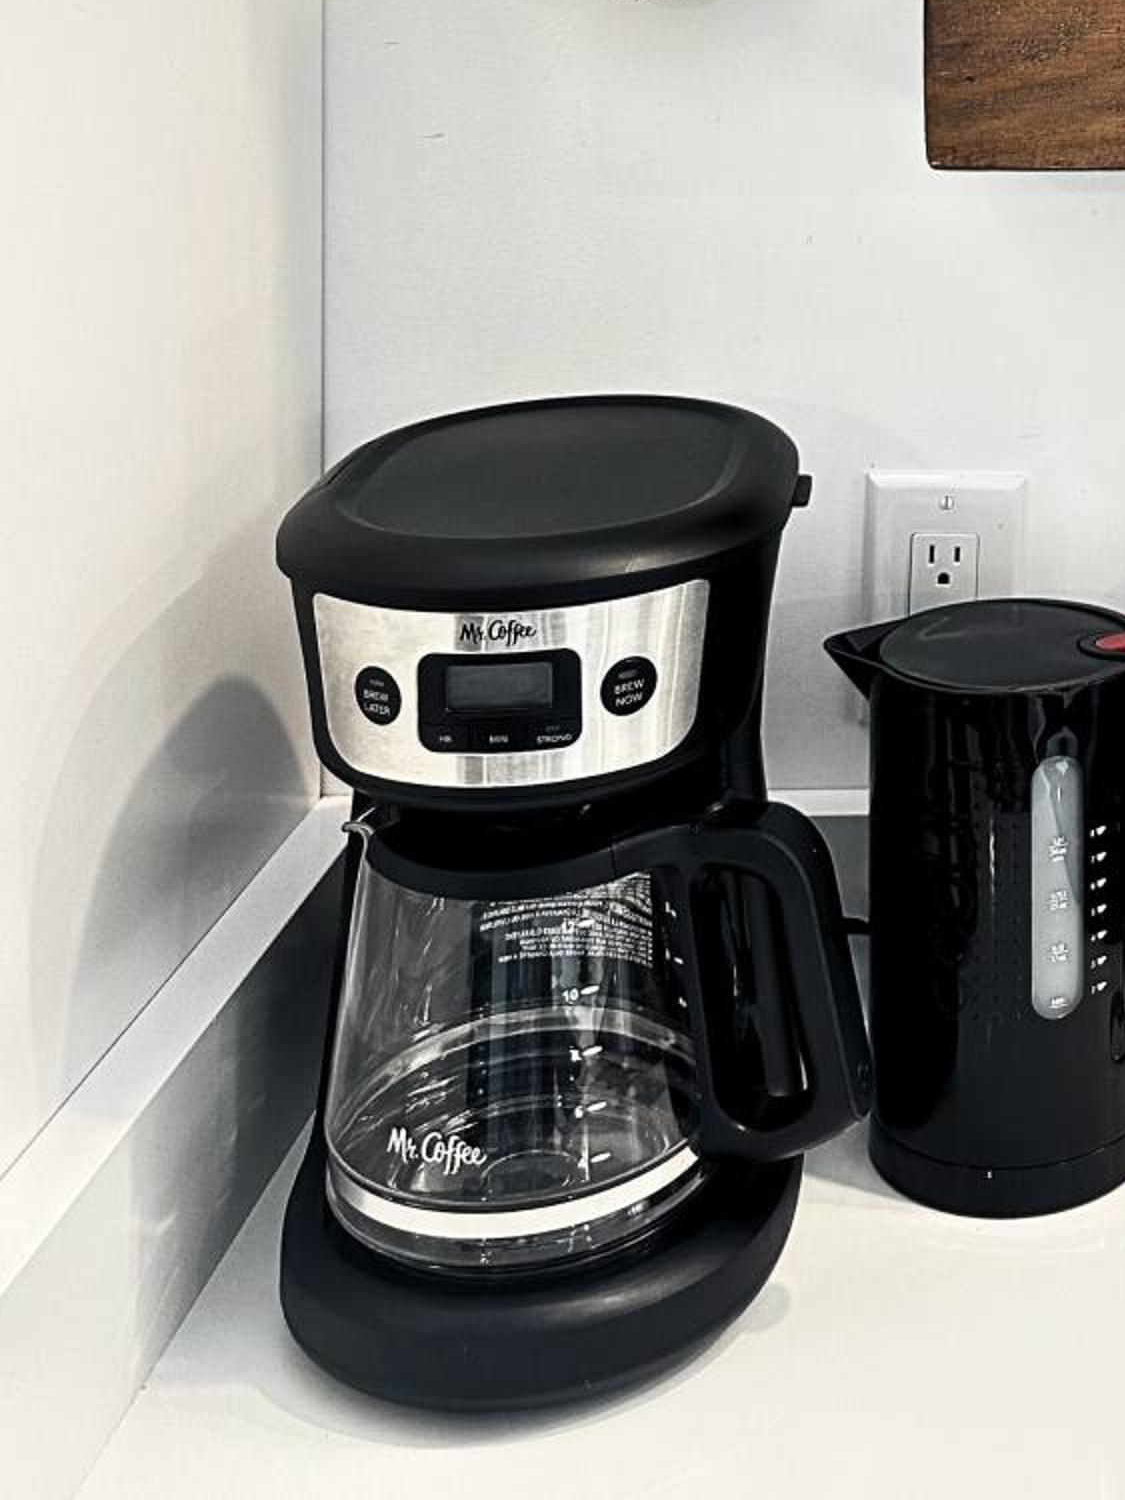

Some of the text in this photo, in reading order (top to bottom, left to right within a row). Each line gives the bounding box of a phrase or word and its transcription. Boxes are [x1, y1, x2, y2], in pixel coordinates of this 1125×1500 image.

[488, 619, 537, 647] Coffee
[614, 678, 645, 695] BREW
[615, 692, 643, 707] NOW
[562, 988, 580, 1002] 10
[386, 1127, 488, 1176] Mr. Coffee
